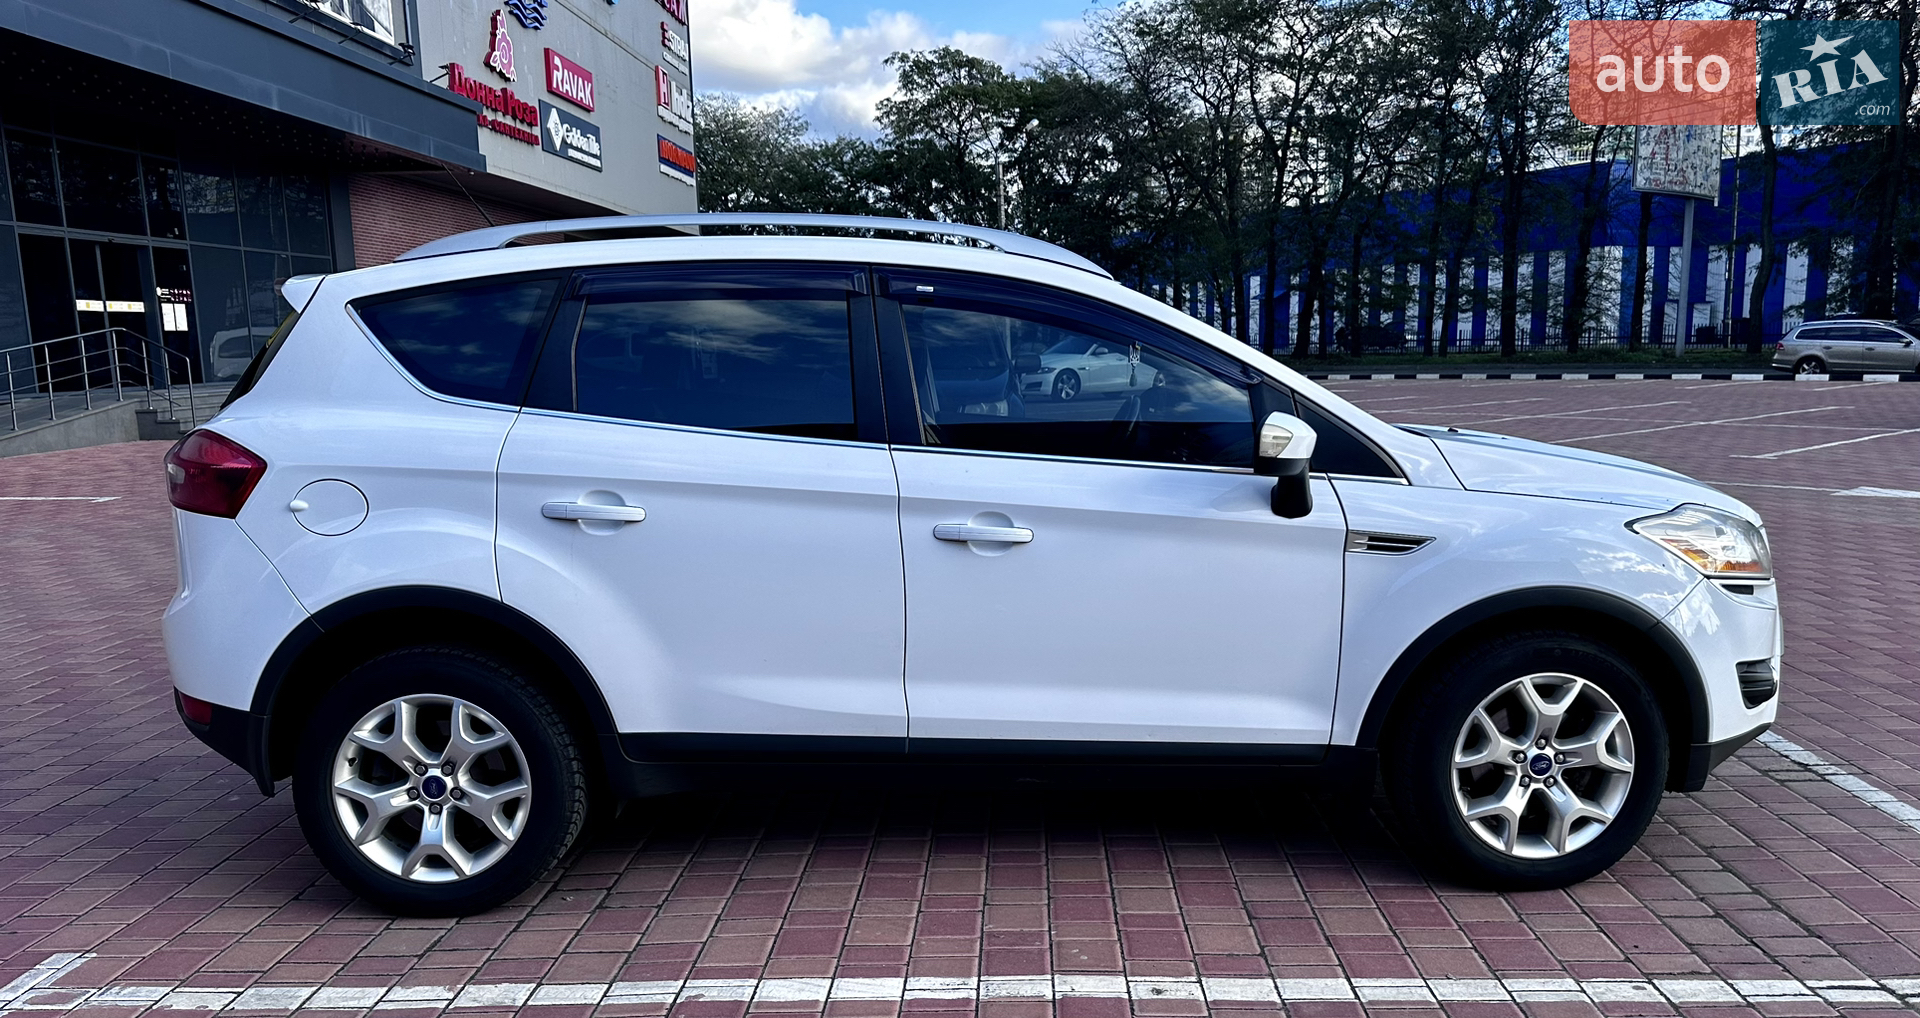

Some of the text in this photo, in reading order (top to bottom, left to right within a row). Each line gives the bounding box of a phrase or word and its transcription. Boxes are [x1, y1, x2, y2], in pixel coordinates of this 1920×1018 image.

[449, 63, 538, 127] Донна Роза
[553, 55, 593, 108] RAVAK
